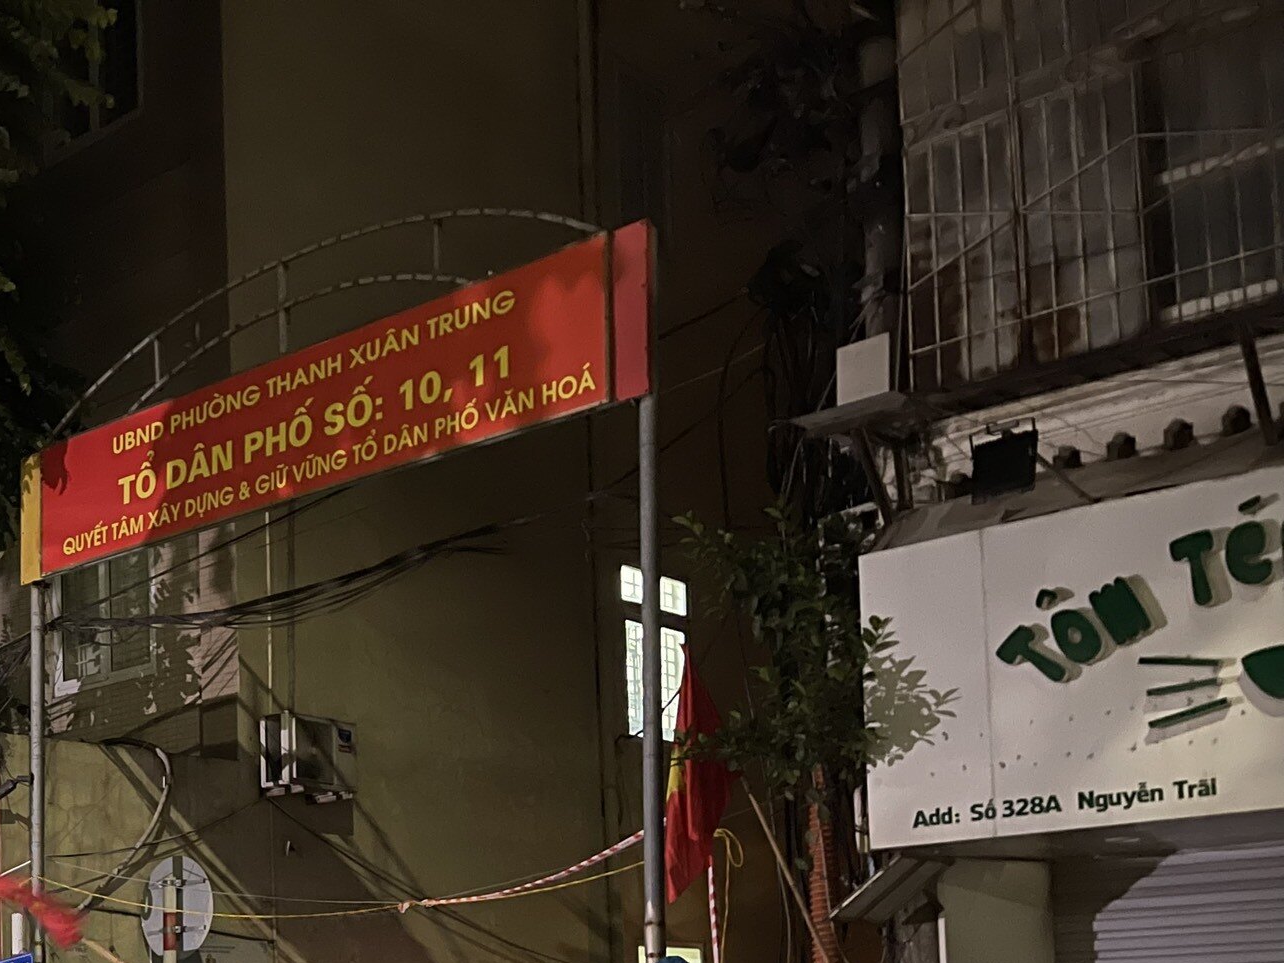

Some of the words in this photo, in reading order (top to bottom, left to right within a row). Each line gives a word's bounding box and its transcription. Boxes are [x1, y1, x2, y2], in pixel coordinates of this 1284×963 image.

[112, 421, 164, 454] UBND
[170, 385, 261, 434] PHƯỜNG
[266, 353, 342, 398] THANH
[348, 325, 419, 368] XUÂN
[426, 290, 516, 339] TRUNG
[117, 450, 157, 505] TỔ
[166, 441, 234, 491] DÂN
[243, 397, 315, 464] PHỐ
[323, 376, 384, 436] SỐ:
[399, 371, 453, 411] 10,
[469, 345, 511, 387] 11
[63, 519, 109, 556] QUYẾT
[112, 512, 144, 542] TÂM
[147, 502, 182, 530] XÂY
[184, 486, 235, 518] DỰNG
[239, 481, 251, 499] &
[255, 464, 291, 494] GIỮ
[292, 450, 348, 483] VỮNG
[352, 429, 378, 465] TỔ
[383, 423, 428, 456] DÂN
[434, 399, 479, 439] PHỐ
[485, 389, 535, 422] VĂN
[541, 362, 597, 405] HOÁ
[912, 806, 961, 829] Add:
[970, 799, 997, 821] Số
[1002, 795, 1062, 818] 328A
[1078, 782, 1164, 812] Nguyễn
